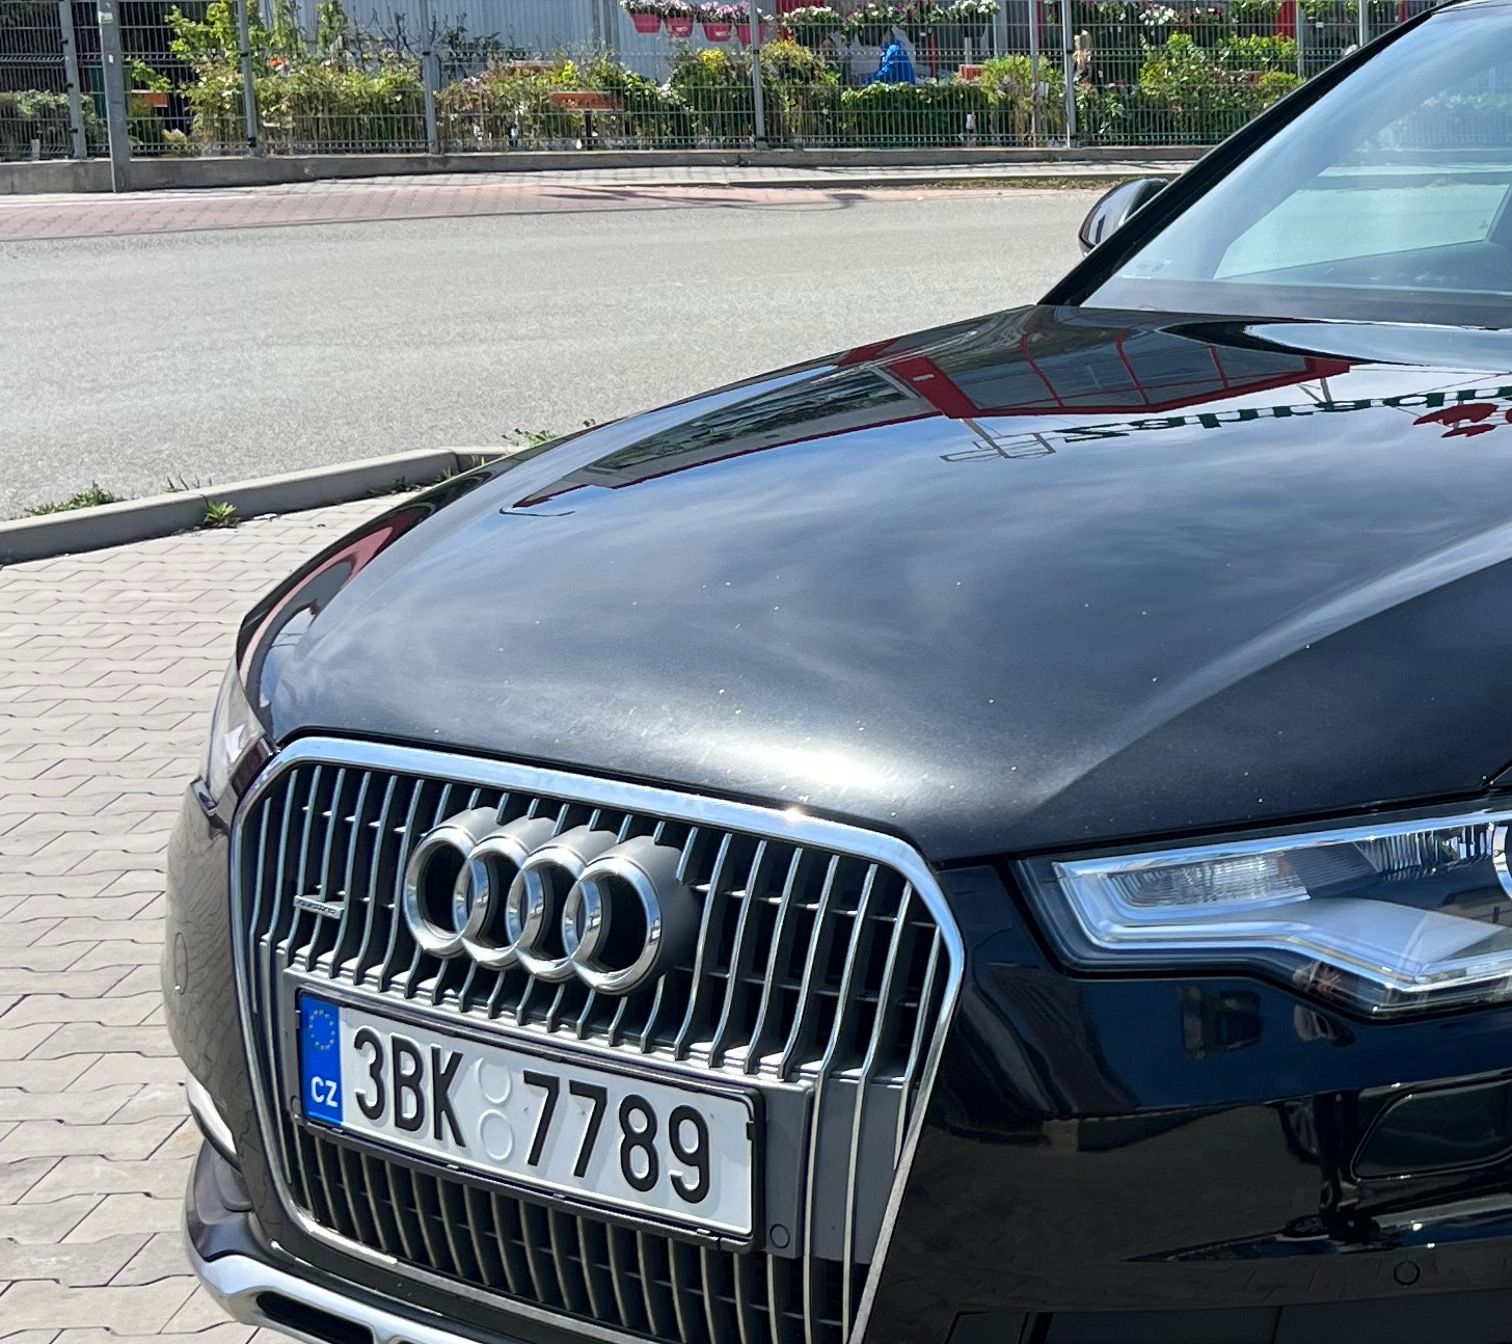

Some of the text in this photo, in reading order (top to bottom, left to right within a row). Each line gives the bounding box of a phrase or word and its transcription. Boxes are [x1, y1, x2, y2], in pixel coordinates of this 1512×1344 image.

[311, 1076, 339, 1108] CZ
[353, 1027, 710, 1204] 3BK 7789
